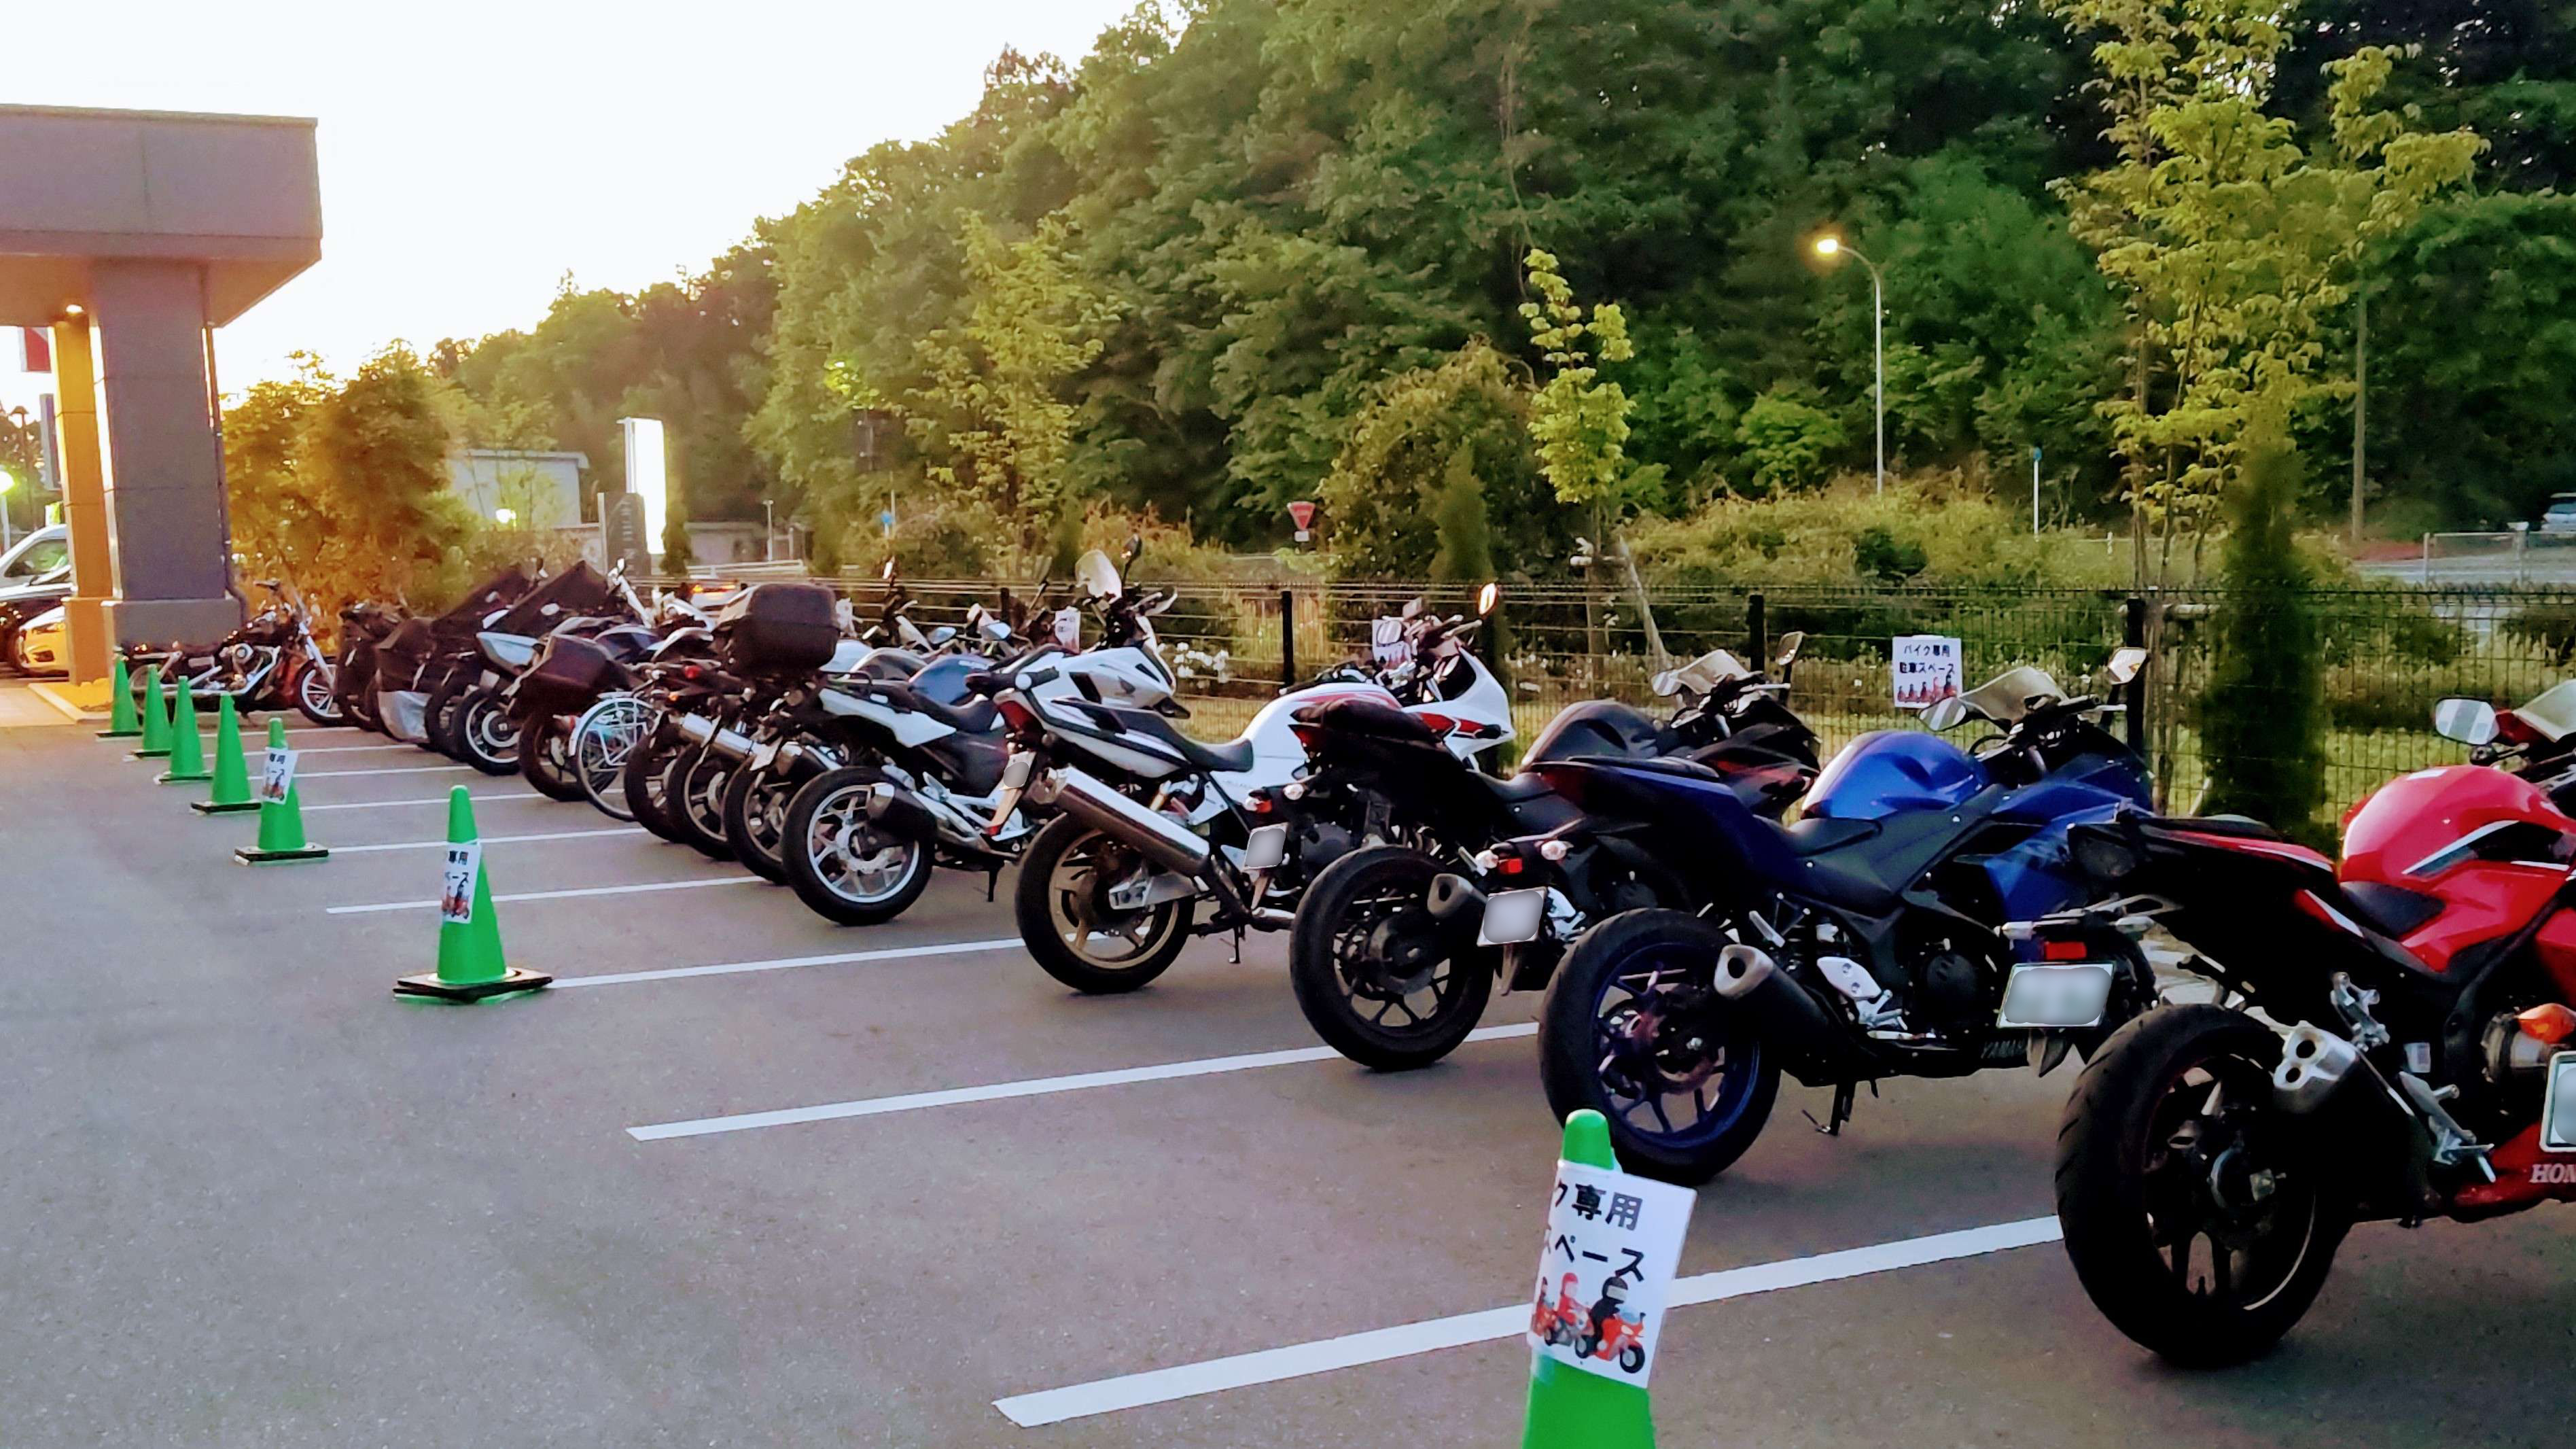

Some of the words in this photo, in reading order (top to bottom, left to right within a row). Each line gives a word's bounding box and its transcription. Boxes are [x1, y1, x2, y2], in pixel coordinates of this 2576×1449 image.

[1904, 644, 1950, 657] バイク専用
[1547, 1226, 1644, 1282] ペース
